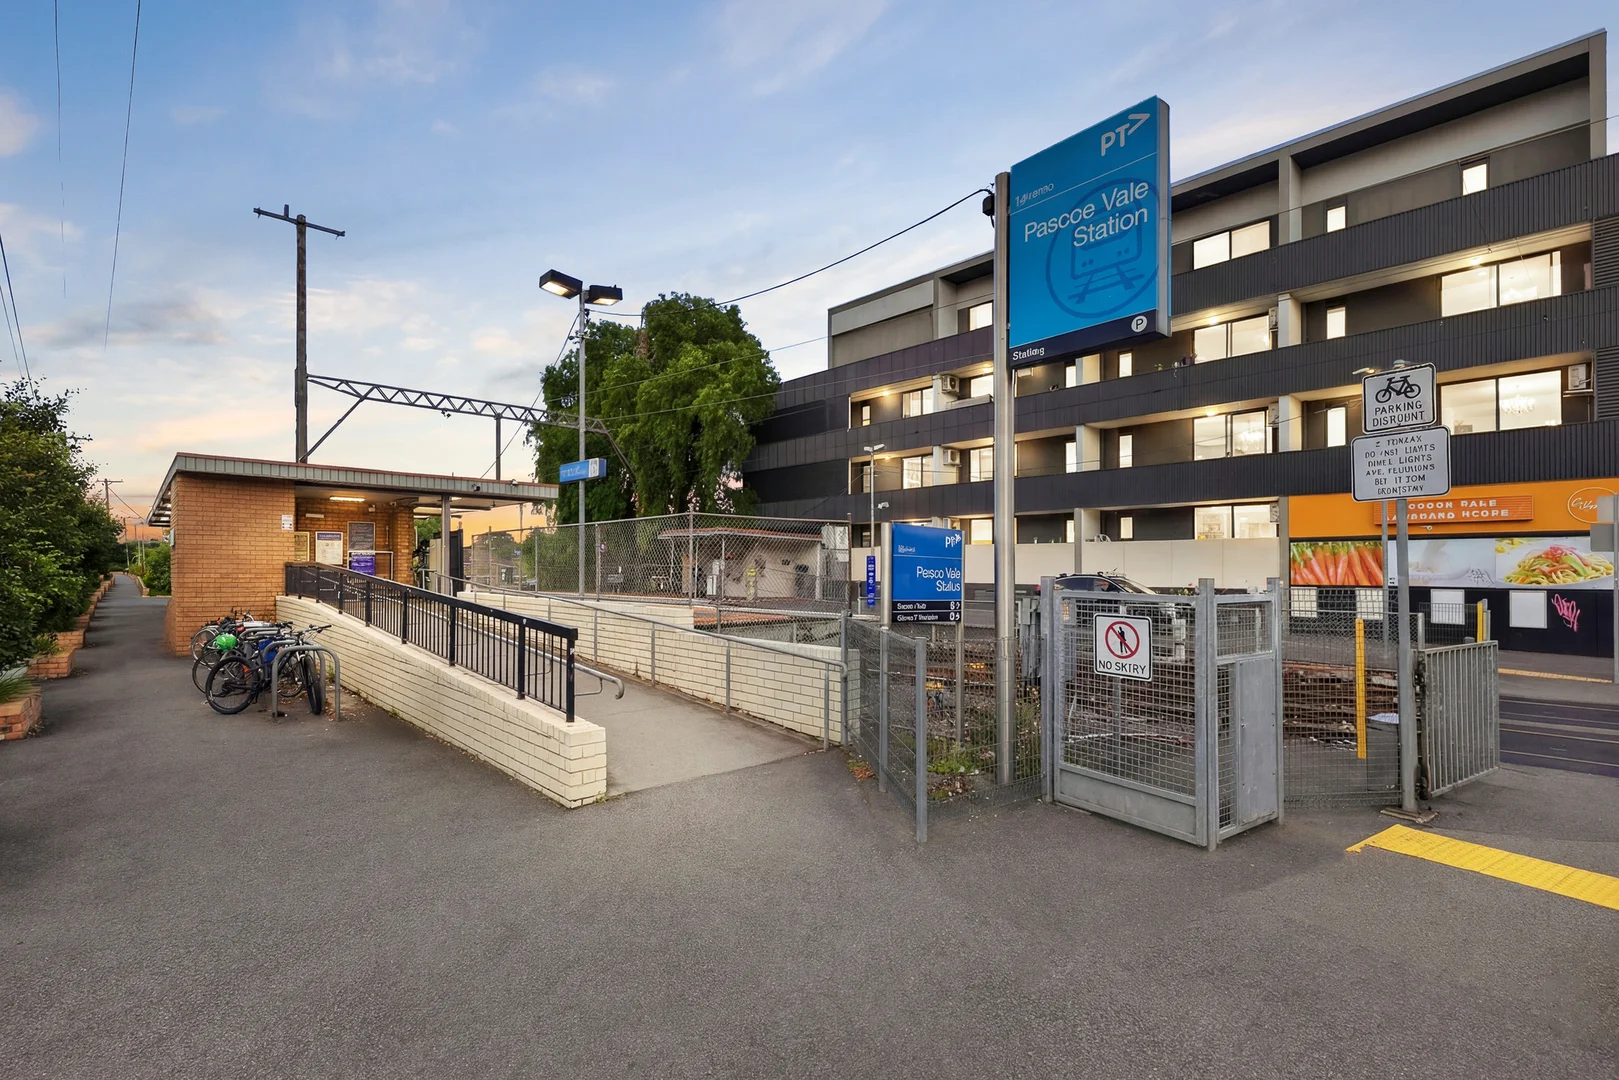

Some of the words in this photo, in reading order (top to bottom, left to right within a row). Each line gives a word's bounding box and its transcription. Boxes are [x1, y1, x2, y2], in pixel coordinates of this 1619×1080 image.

[1102, 182, 1149, 211] Vale
[1073, 207, 1148, 247] Station
[1374, 400, 1423, 416] PARKING
[1098, 659, 1113, 670] NO
